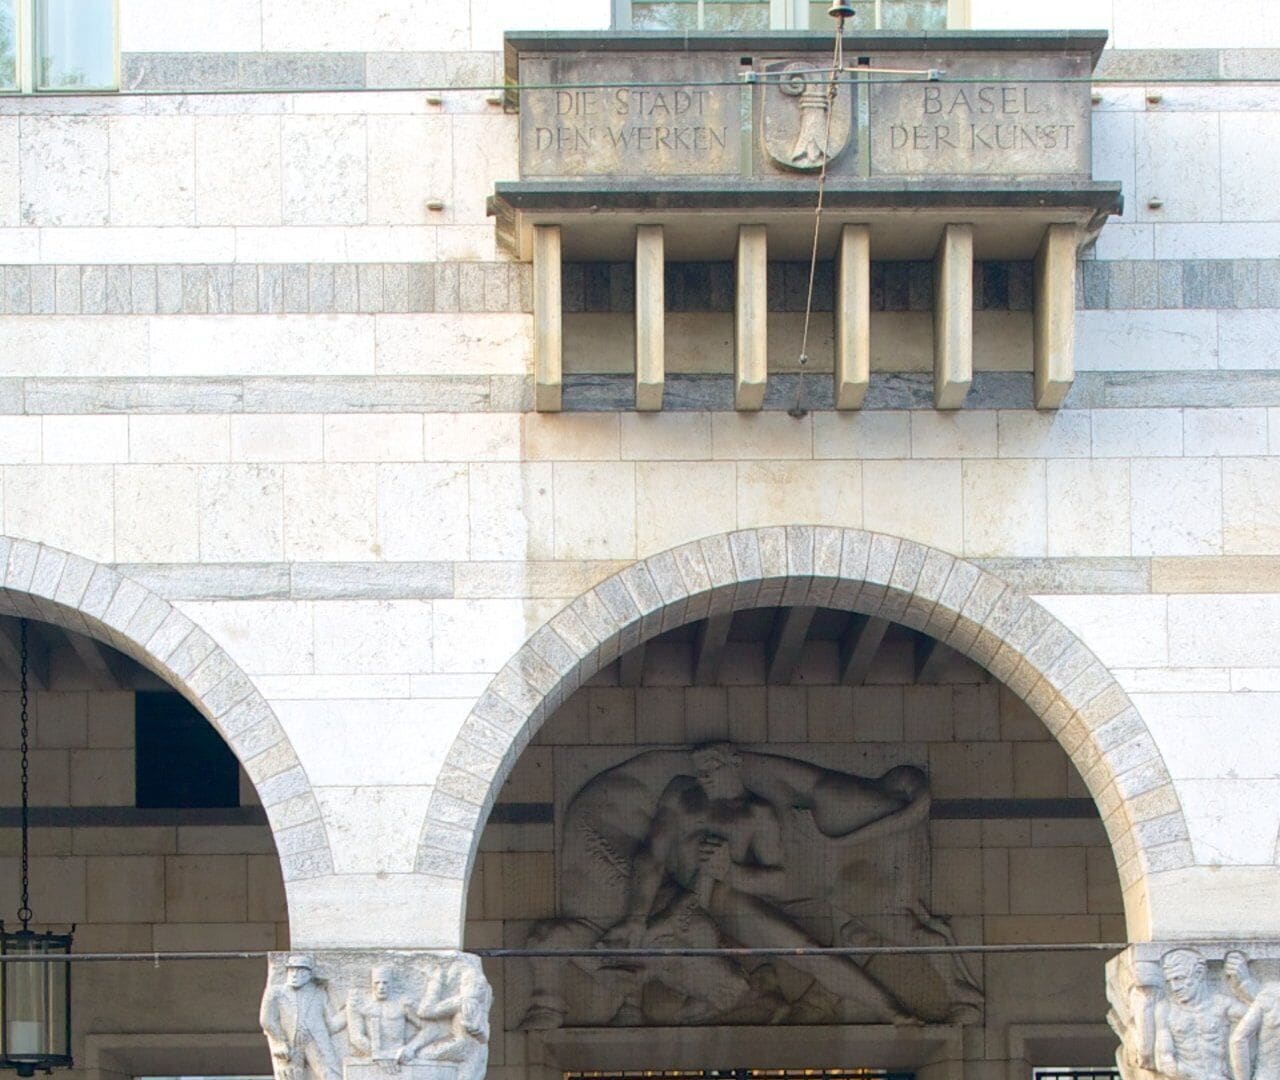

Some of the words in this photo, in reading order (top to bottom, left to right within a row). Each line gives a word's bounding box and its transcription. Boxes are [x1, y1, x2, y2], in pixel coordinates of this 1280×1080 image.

[555, 90, 598, 116] DIE
[615, 87, 710, 116] STADT
[922, 86, 1041, 115] BASEL
[534, 126, 595, 151] DEN
[606, 125, 729, 151] WERKEN
[889, 124, 958, 151] DER
[970, 123, 1076, 151] KUNST
